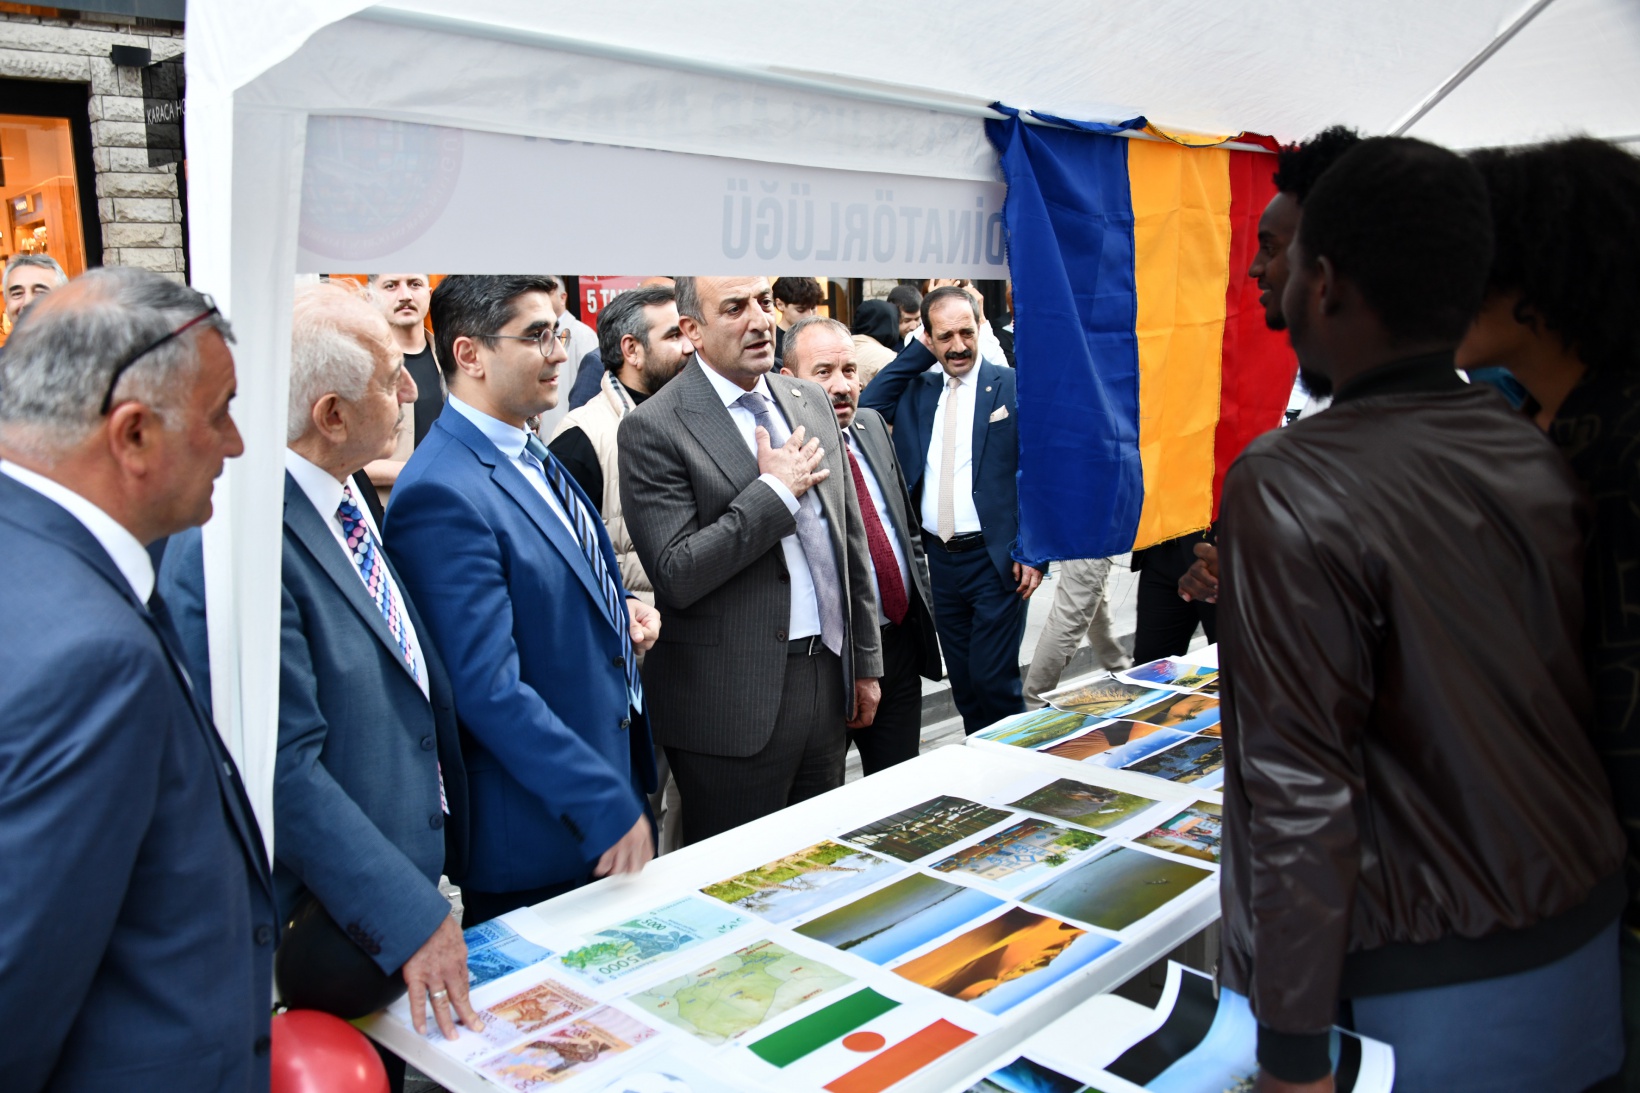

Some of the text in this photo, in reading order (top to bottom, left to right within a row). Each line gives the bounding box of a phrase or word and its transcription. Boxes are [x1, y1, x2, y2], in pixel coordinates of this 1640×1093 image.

[147, 103, 174, 125] KARACA
[586, 289, 597, 313] 5
[480, 926, 500, 941] 2000
[641, 919, 667, 931] 5000
[599, 955, 640, 975] 5000
